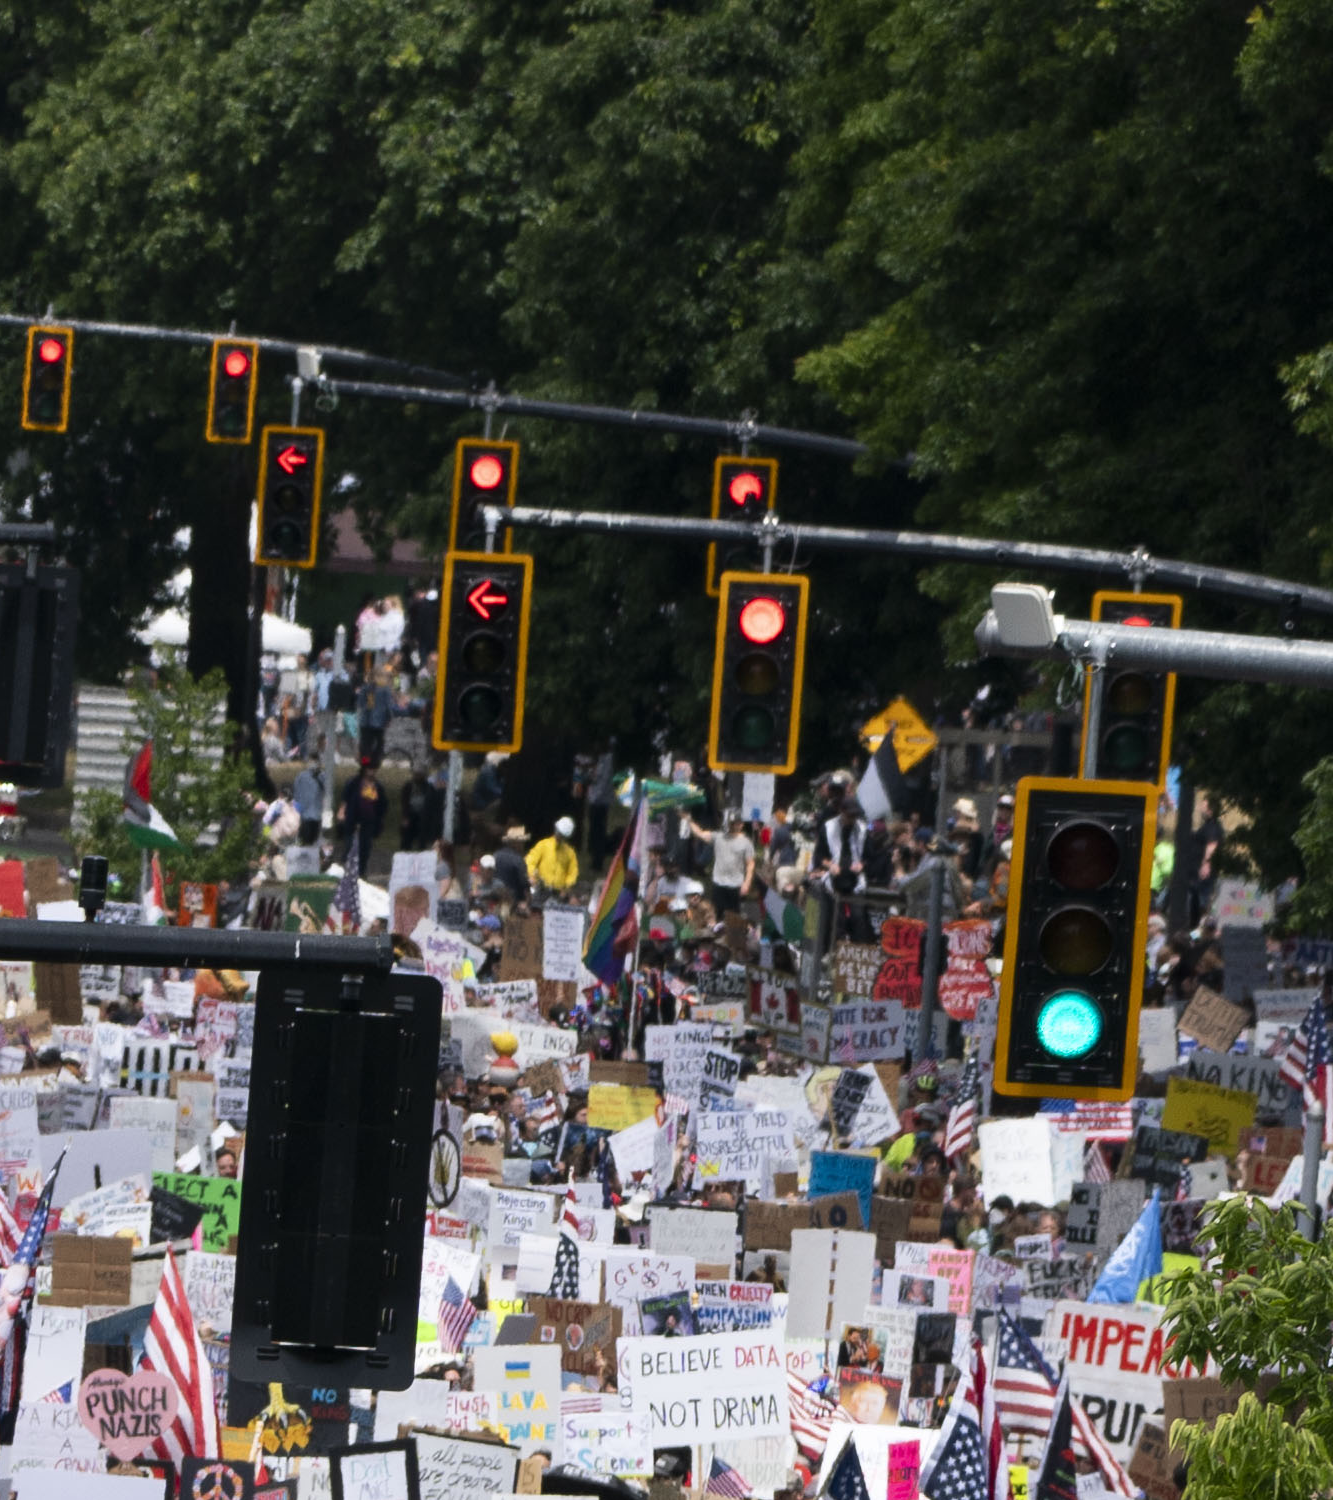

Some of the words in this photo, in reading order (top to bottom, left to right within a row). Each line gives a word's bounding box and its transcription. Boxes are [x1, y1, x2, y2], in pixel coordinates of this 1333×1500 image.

[641, 1345, 724, 1377] BELIEVE
[734, 1342, 780, 1370] DATA
[86, 1386, 170, 1420] PUNCH
[649, 1401, 703, 1431] NOT
[713, 1395, 779, 1426] DRAMA
[100, 1412, 161, 1438] NAZIS
[565, 1421, 633, 1442] Support
[577, 1448, 645, 1472] Science
